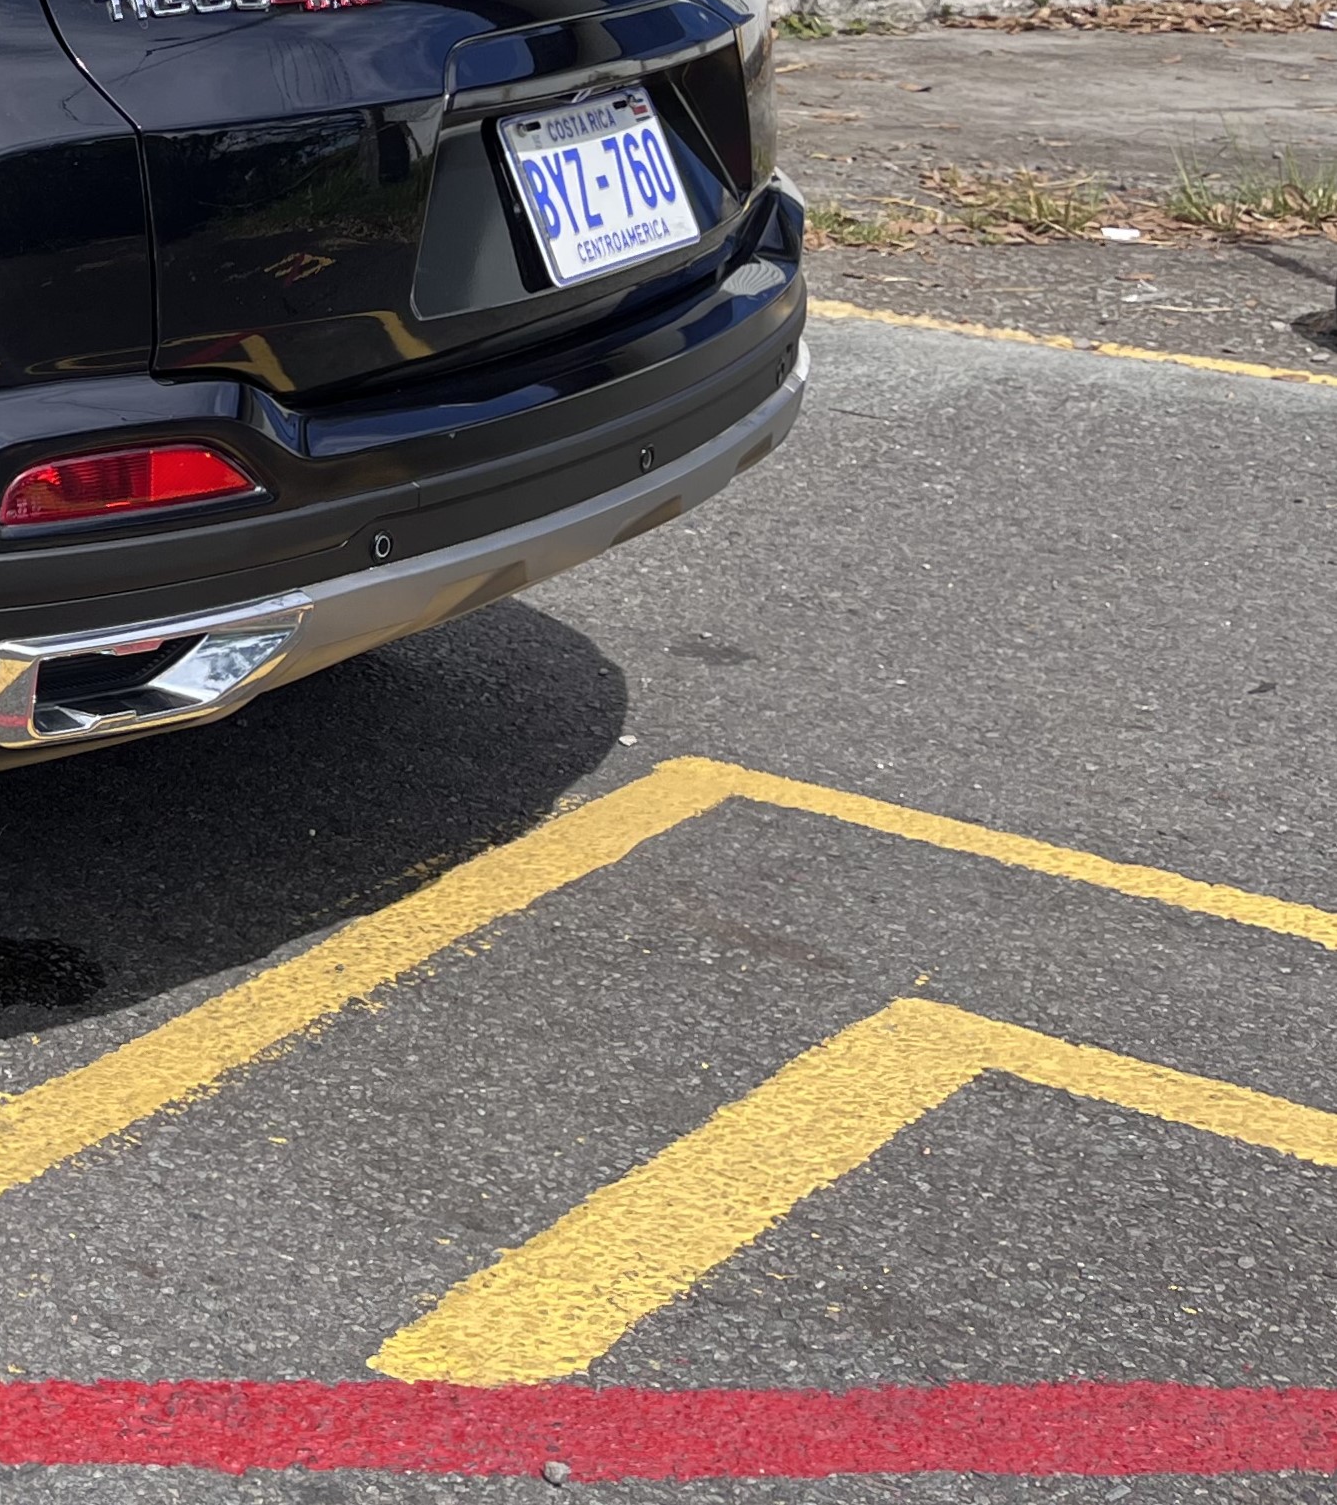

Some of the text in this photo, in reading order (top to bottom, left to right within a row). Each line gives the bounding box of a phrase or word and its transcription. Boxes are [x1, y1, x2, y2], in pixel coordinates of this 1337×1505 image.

[547, 108, 616, 142] COSTA RICA
[523, 128, 677, 239] BYZ-760
[577, 217, 671, 262] CENTROAMERICA
